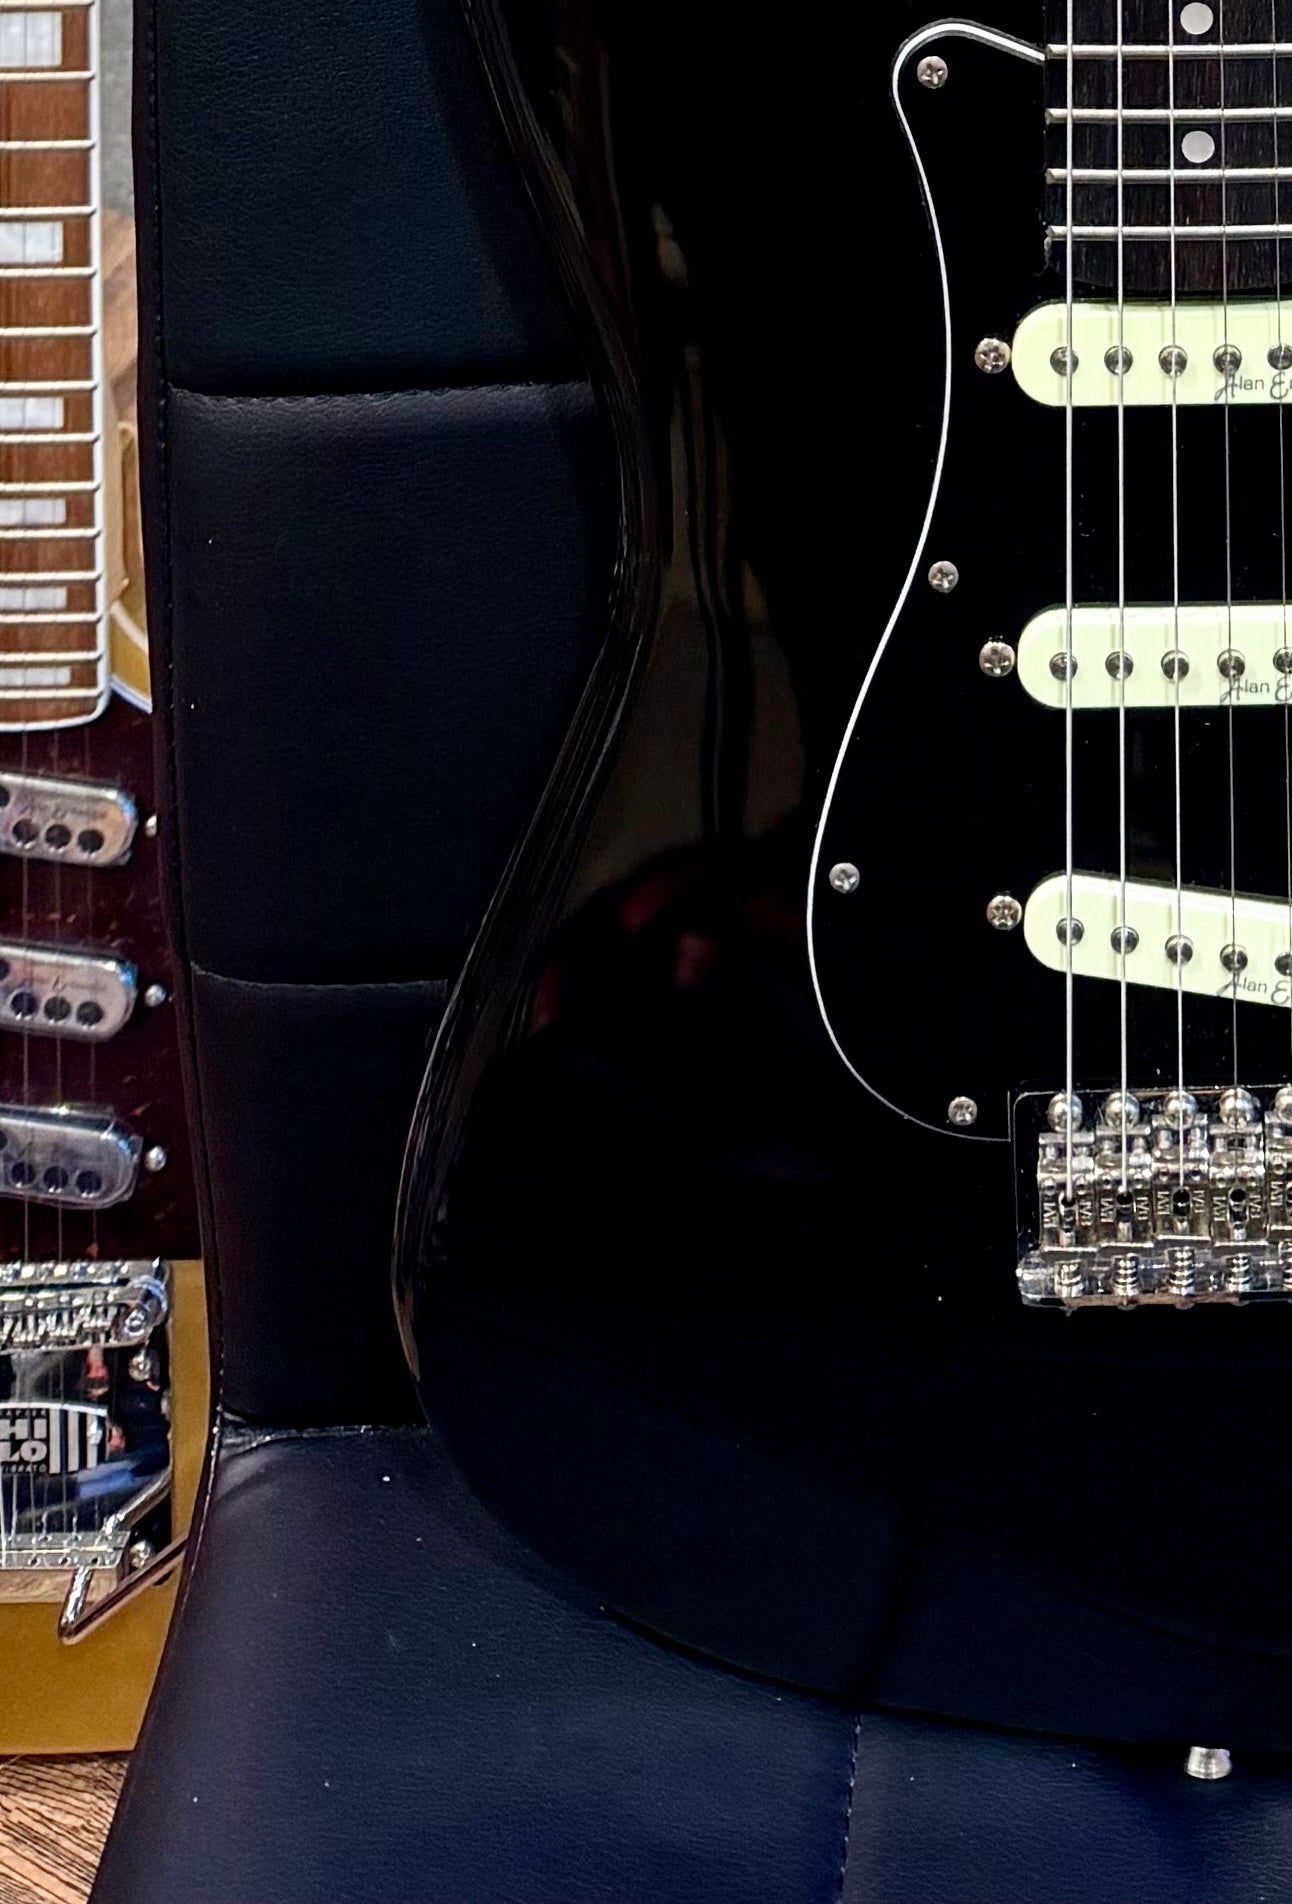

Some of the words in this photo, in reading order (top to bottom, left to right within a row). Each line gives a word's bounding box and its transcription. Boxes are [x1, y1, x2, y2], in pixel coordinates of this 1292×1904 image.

[1214, 372, 1265, 401] Alan
[1220, 675, 1270, 703] Alan
[1217, 971, 1267, 997] Alan
